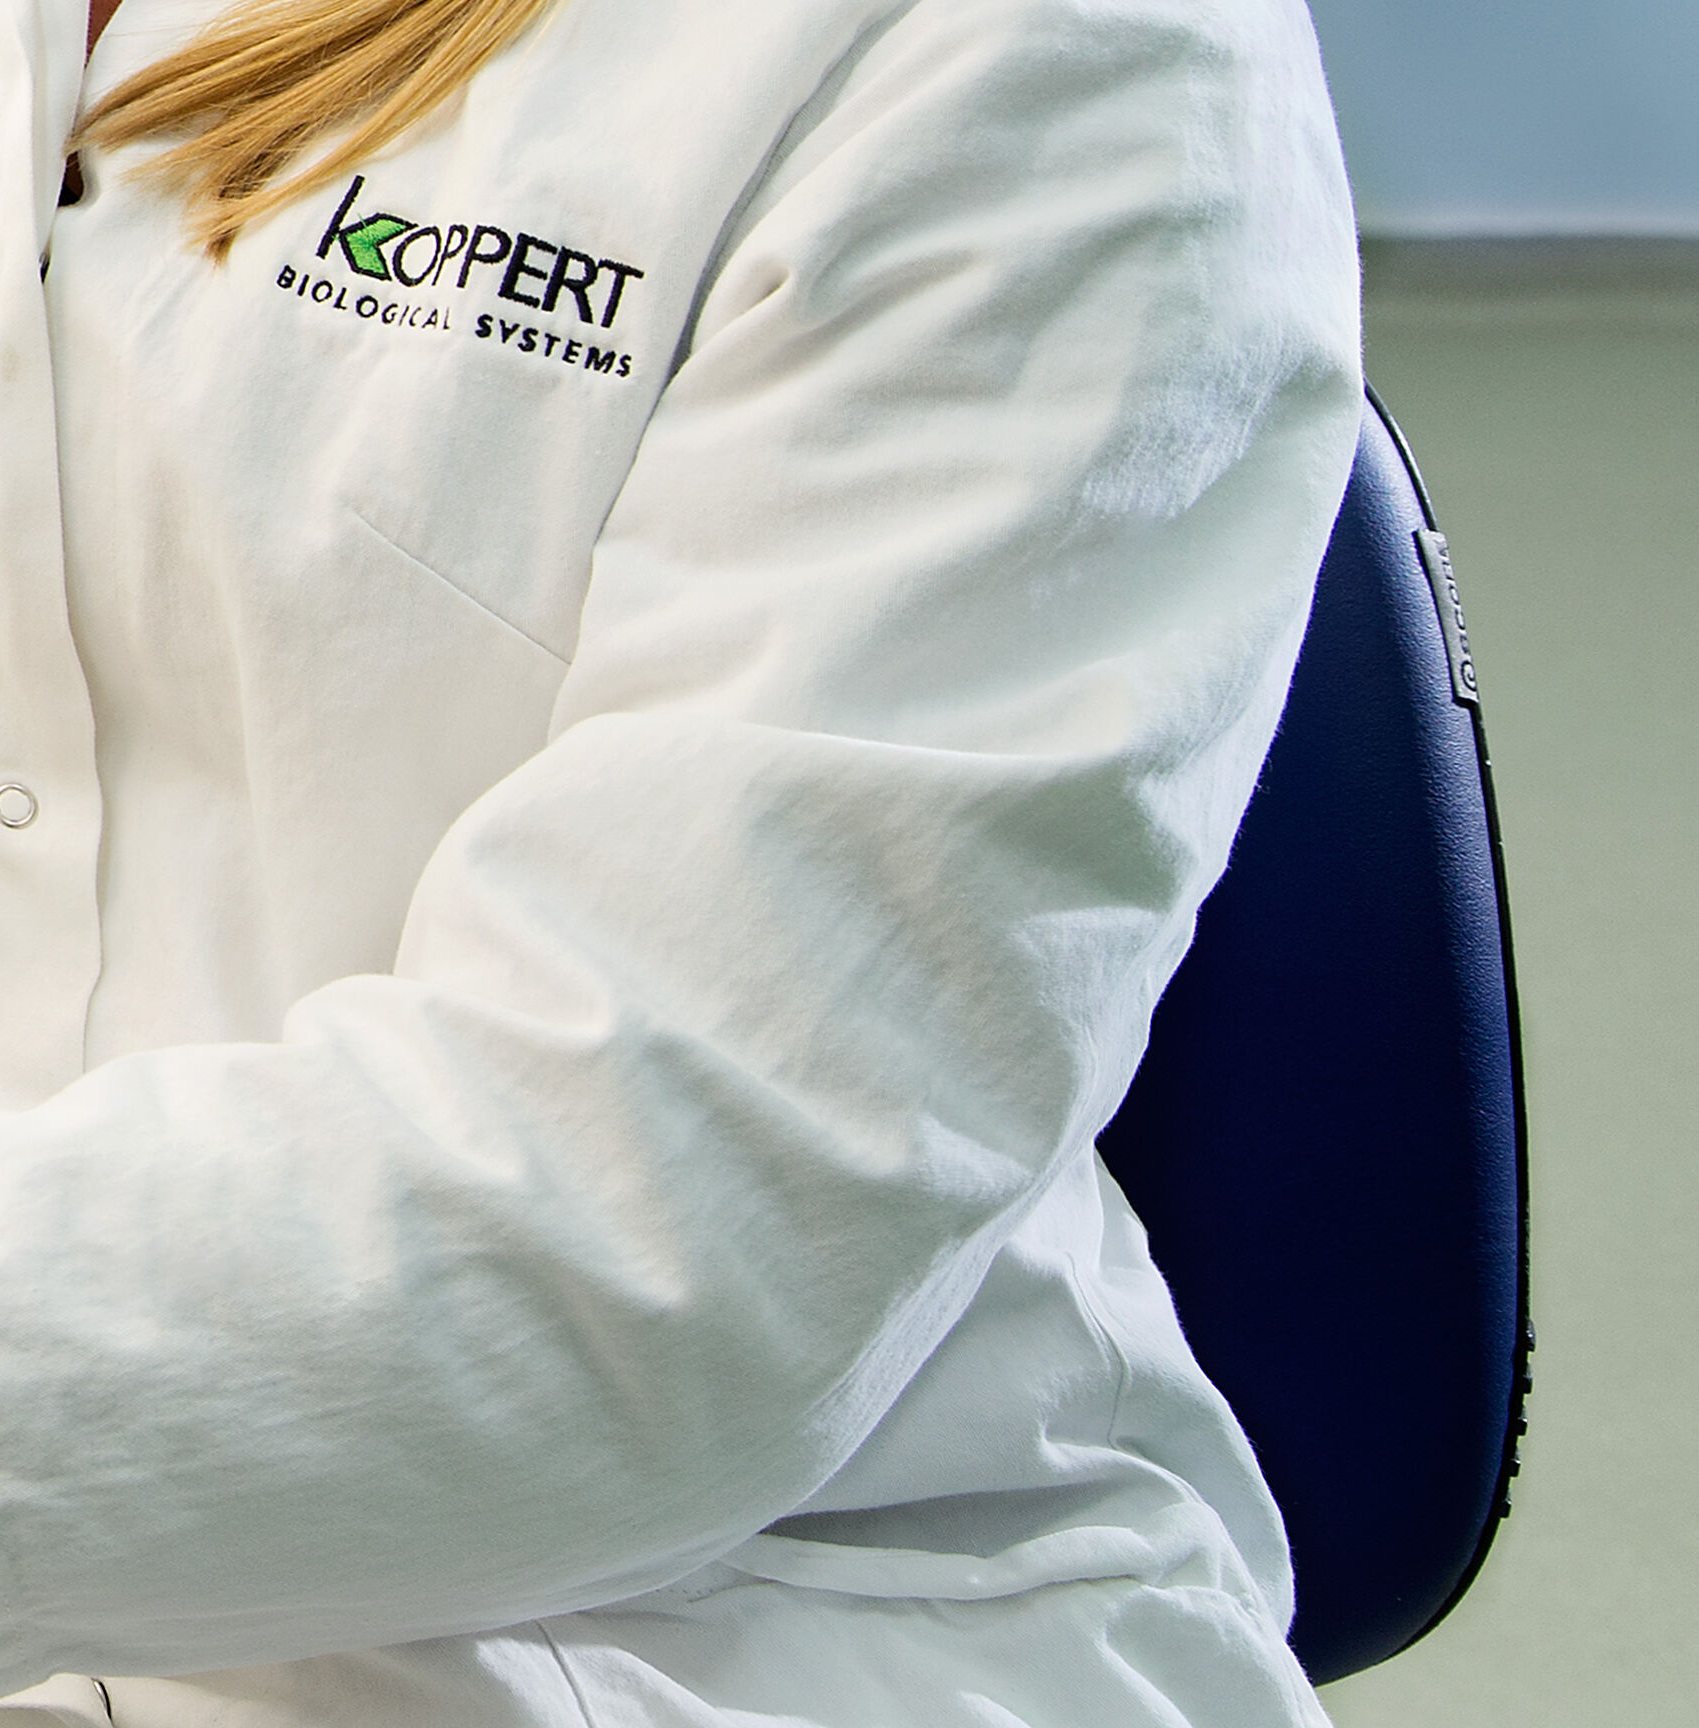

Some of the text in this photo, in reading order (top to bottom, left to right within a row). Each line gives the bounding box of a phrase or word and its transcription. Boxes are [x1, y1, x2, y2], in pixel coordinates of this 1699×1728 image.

[315, 174, 645, 328] KOPPERT
[276, 264, 633, 378] BIOLOGICAL SYSTEMS
